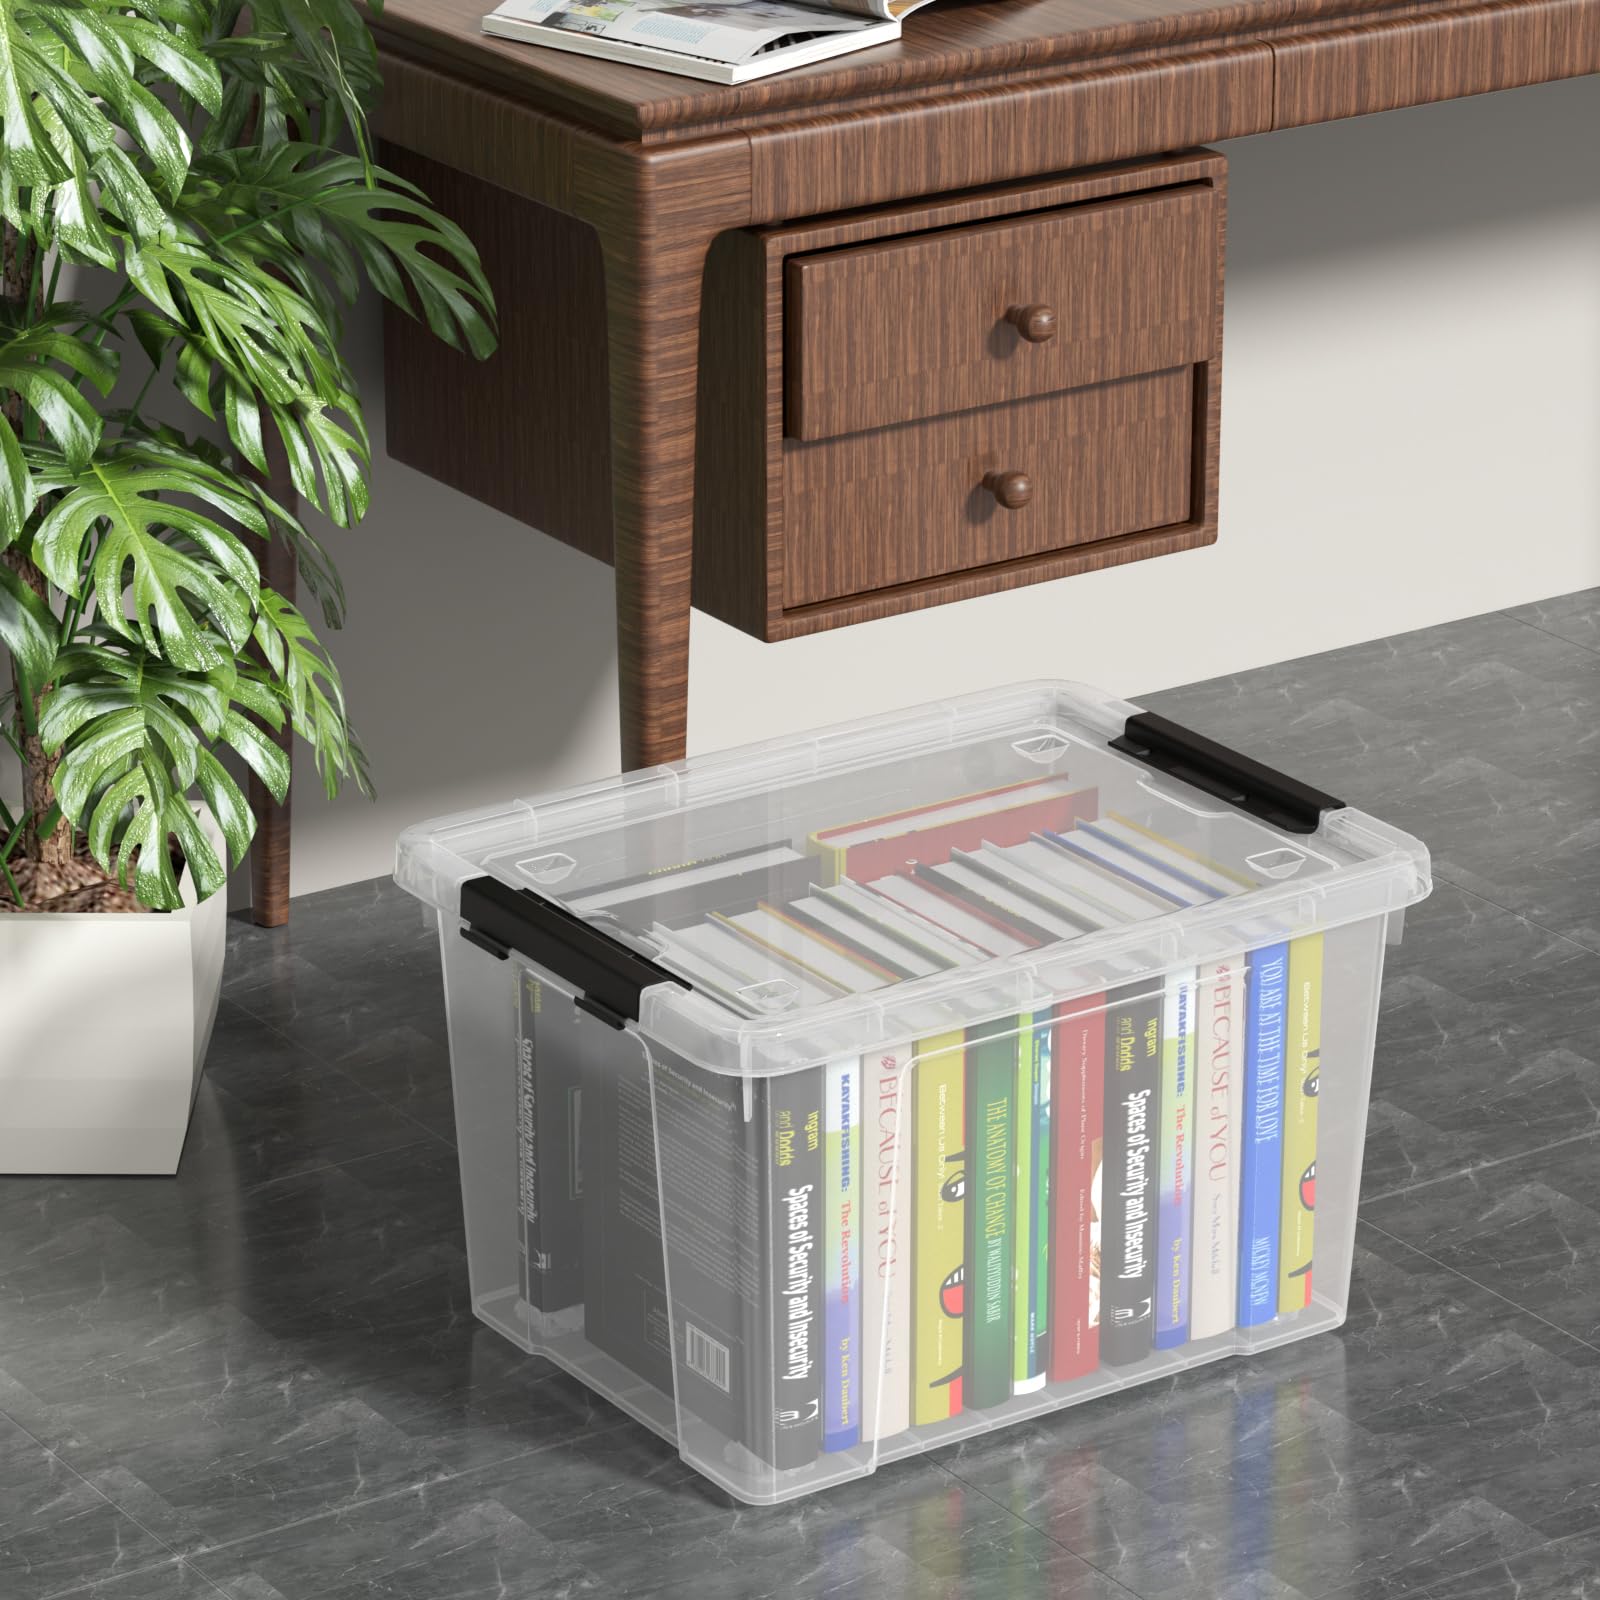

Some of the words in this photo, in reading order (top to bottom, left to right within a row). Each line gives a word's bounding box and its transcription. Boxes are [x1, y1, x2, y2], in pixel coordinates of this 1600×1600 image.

[1259, 957, 1284, 987] YOU
[1258, 986, 1282, 1011] ARE
[1302, 980, 1312, 1032] Between
[1258, 1011, 1282, 1028] AT
[1143, 1018, 1160, 1057] Ingram
[1210, 985, 1232, 1100] BECAUSE
[1257, 1026, 1282, 1055] THE
[1256, 1052, 1281, 1086] TIME
[937, 1083, 948, 1133] Between
[986, 1097, 1008, 1122] THE
[1120, 1089, 1151, 1133] Spaces
[1209, 1106, 1228, 1121] of
[1255, 1084, 1280, 1113] FOR
[841, 1073, 851, 1192] KAYAKFISHING:
[1175, 1104, 1187, 1131] The
[1254, 1110, 1279, 1145] LOVE
[878, 1076, 901, 1194] BECAUSE
[985, 1122, 1007, 1175] ANATOMY
[1126, 1133, 1151, 1146] of
[1173, 1132, 1186, 1207] Revolution
[1208, 1123, 1230, 1182] YOU
[985, 1175, 1007, 1191] OF
[1118, 1144, 1149, 1197] Security
[781, 1184, 814, 1230] Spaces
[841, 1200, 852, 1227] The
[984, 1192, 1006, 1239] CHANGE
[1124, 1196, 1149, 1221] and
[788, 1228, 814, 1244] of
[878, 1219, 900, 1279] YOU
[986, 1238, 1002, 1248] BY
[1117, 1218, 1149, 1280] Insecurity
[781, 1241, 814, 1295] Security
[840, 1229, 852, 1304] Revolution
[788, 1294, 814, 1319] and
[985, 1300, 1002, 1324] SABIR
[781, 1317, 814, 1380] Insecurity
[839, 1337, 851, 1352] by
[841, 1354, 851, 1378] Ken
